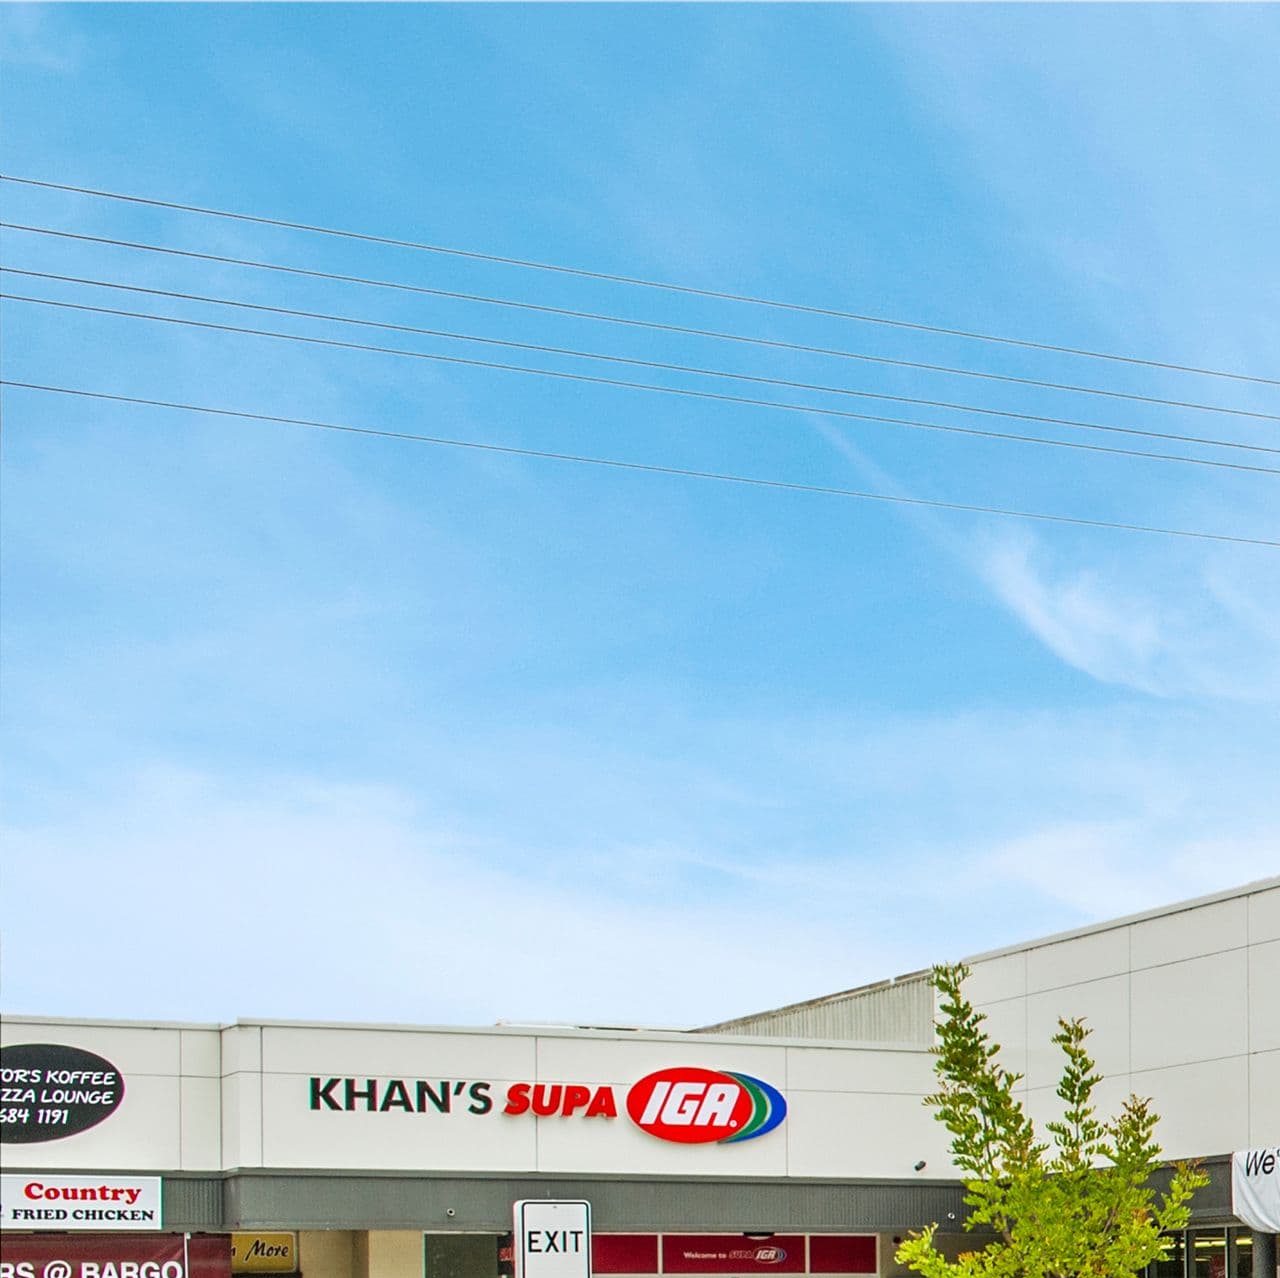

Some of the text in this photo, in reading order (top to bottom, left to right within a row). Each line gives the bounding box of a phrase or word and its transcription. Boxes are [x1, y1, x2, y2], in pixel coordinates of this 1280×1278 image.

[0, 1069, 116, 1085] OR'S KOFFEE
[41, 1090, 114, 1104] LOUNGE
[310, 1077, 738, 1127] KHAN'S SUPA IGA
[37, 1109, 69, 1124] 1191
[24, 1183, 142, 1204] Country
[12, 1209, 154, 1221] FRIED CHICKEN
[528, 1231, 583, 1252] EXIT
[244, 1240, 289, 1263] More
[756, 1250, 776, 1260] IGA
